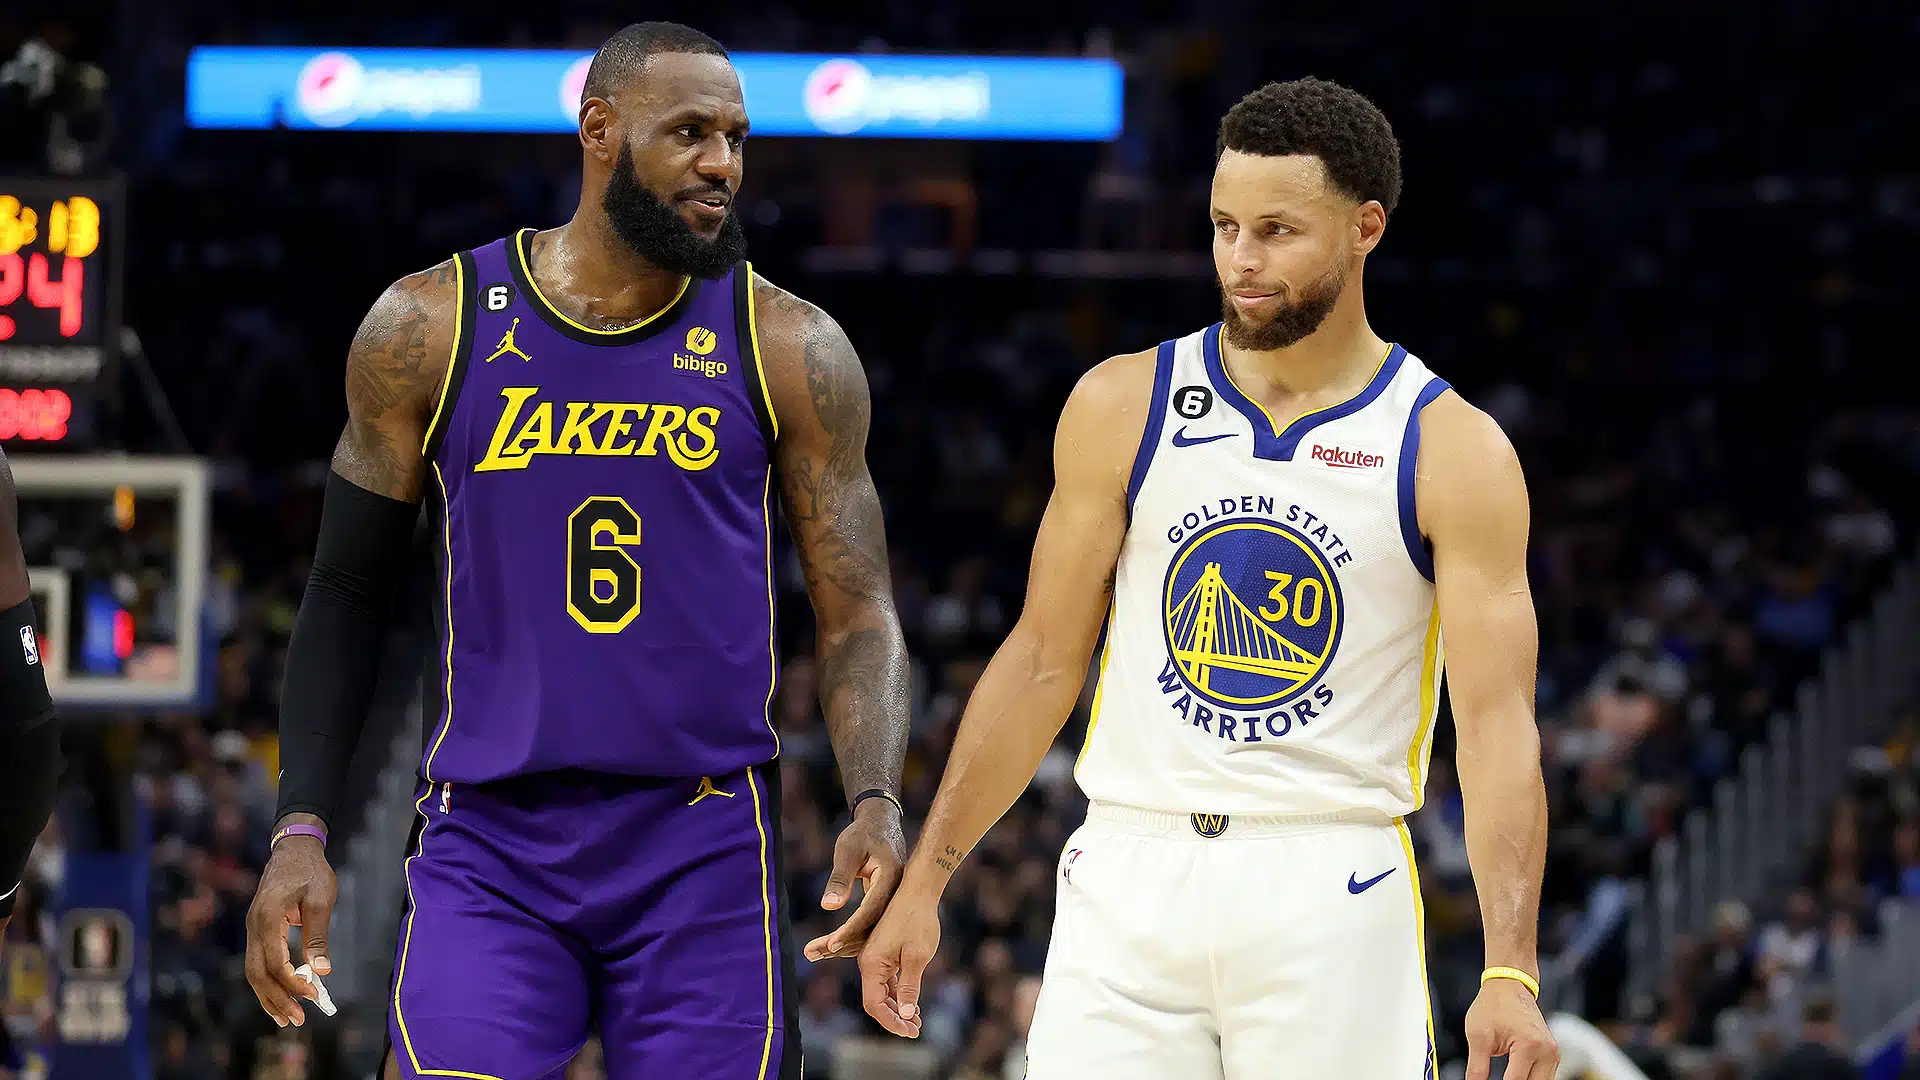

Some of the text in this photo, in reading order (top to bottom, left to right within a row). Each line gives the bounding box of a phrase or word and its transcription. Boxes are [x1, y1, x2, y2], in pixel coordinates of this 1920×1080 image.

[488, 286, 508, 311] 6
[673, 352, 728, 378] bibigo
[474, 385, 722, 472] LAKERS
[1181, 390, 1206, 416] 6
[1311, 444, 1384, 469] Rakuten
[1167, 495, 1353, 569] GOLDEN STATE
[566, 495, 642, 634] 6
[1258, 569, 1324, 627] 30
[1157, 656, 1334, 743] WARRIORS
